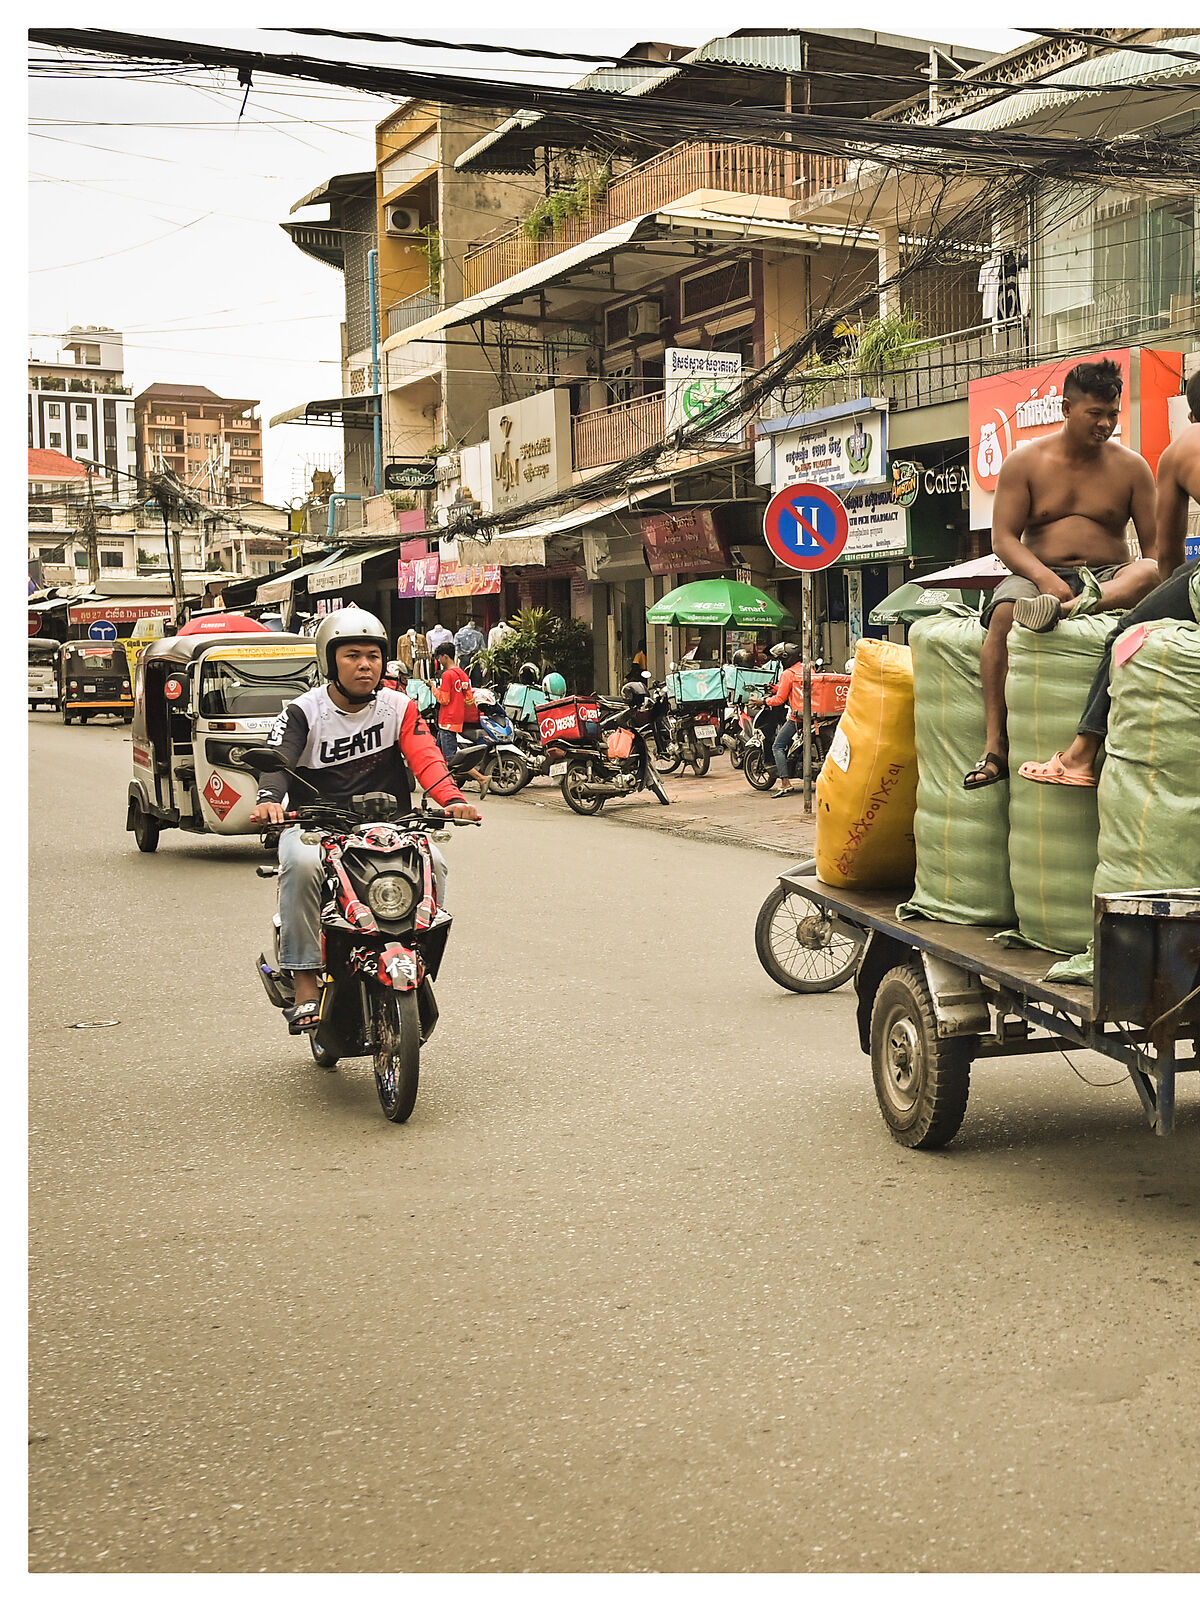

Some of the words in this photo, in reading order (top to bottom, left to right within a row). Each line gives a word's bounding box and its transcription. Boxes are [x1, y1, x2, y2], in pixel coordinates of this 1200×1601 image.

[924, 466, 957, 495] Café
[870, 511, 899, 524] PHARMACY
[126, 610, 137, 618] Da
[138, 609, 149, 618] lin
[738, 604, 766, 613] Smart
[320, 722, 385, 764] LEATT
[386, 954, 416, 980] 侍
